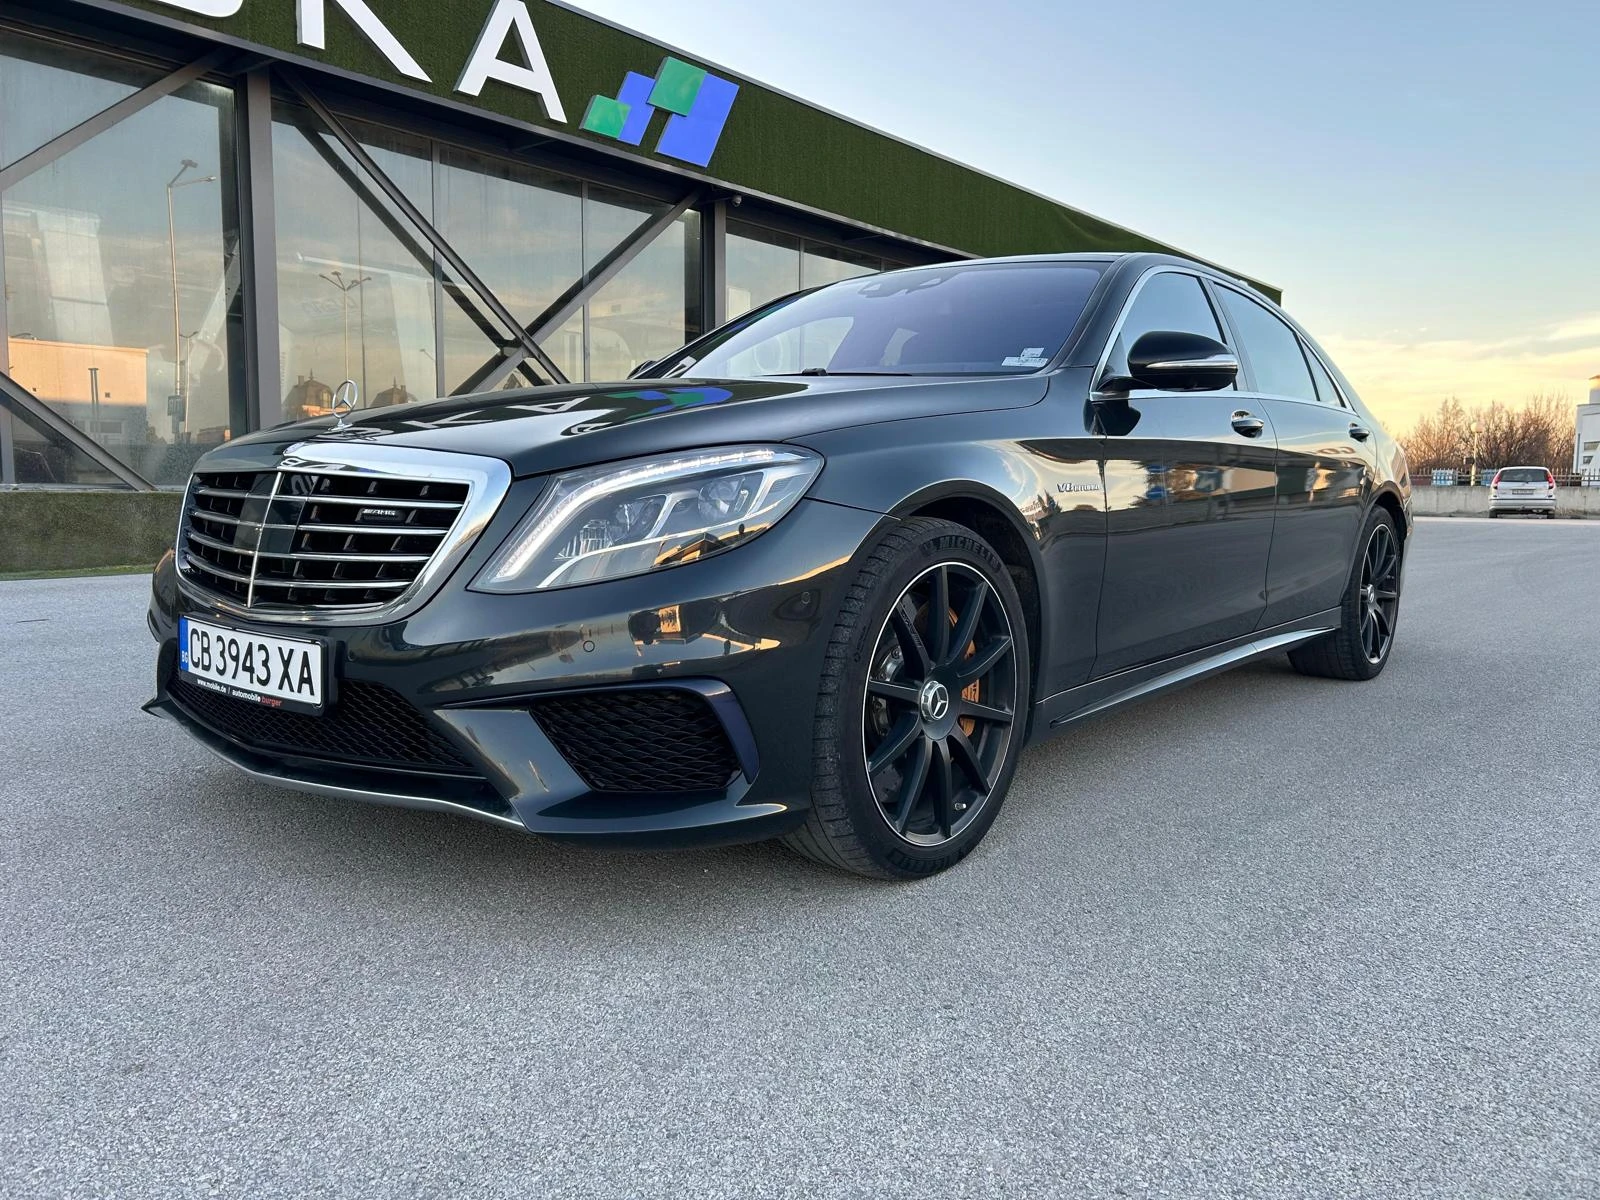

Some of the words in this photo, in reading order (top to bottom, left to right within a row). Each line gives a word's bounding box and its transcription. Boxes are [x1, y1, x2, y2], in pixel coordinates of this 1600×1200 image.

[938, 534, 1002, 572] MICHELIN
[189, 627, 212, 672] CB
[215, 634, 272, 687] 3943
[277, 646, 315, 696] XA
[196, 678, 227, 694] www.mobile.de
